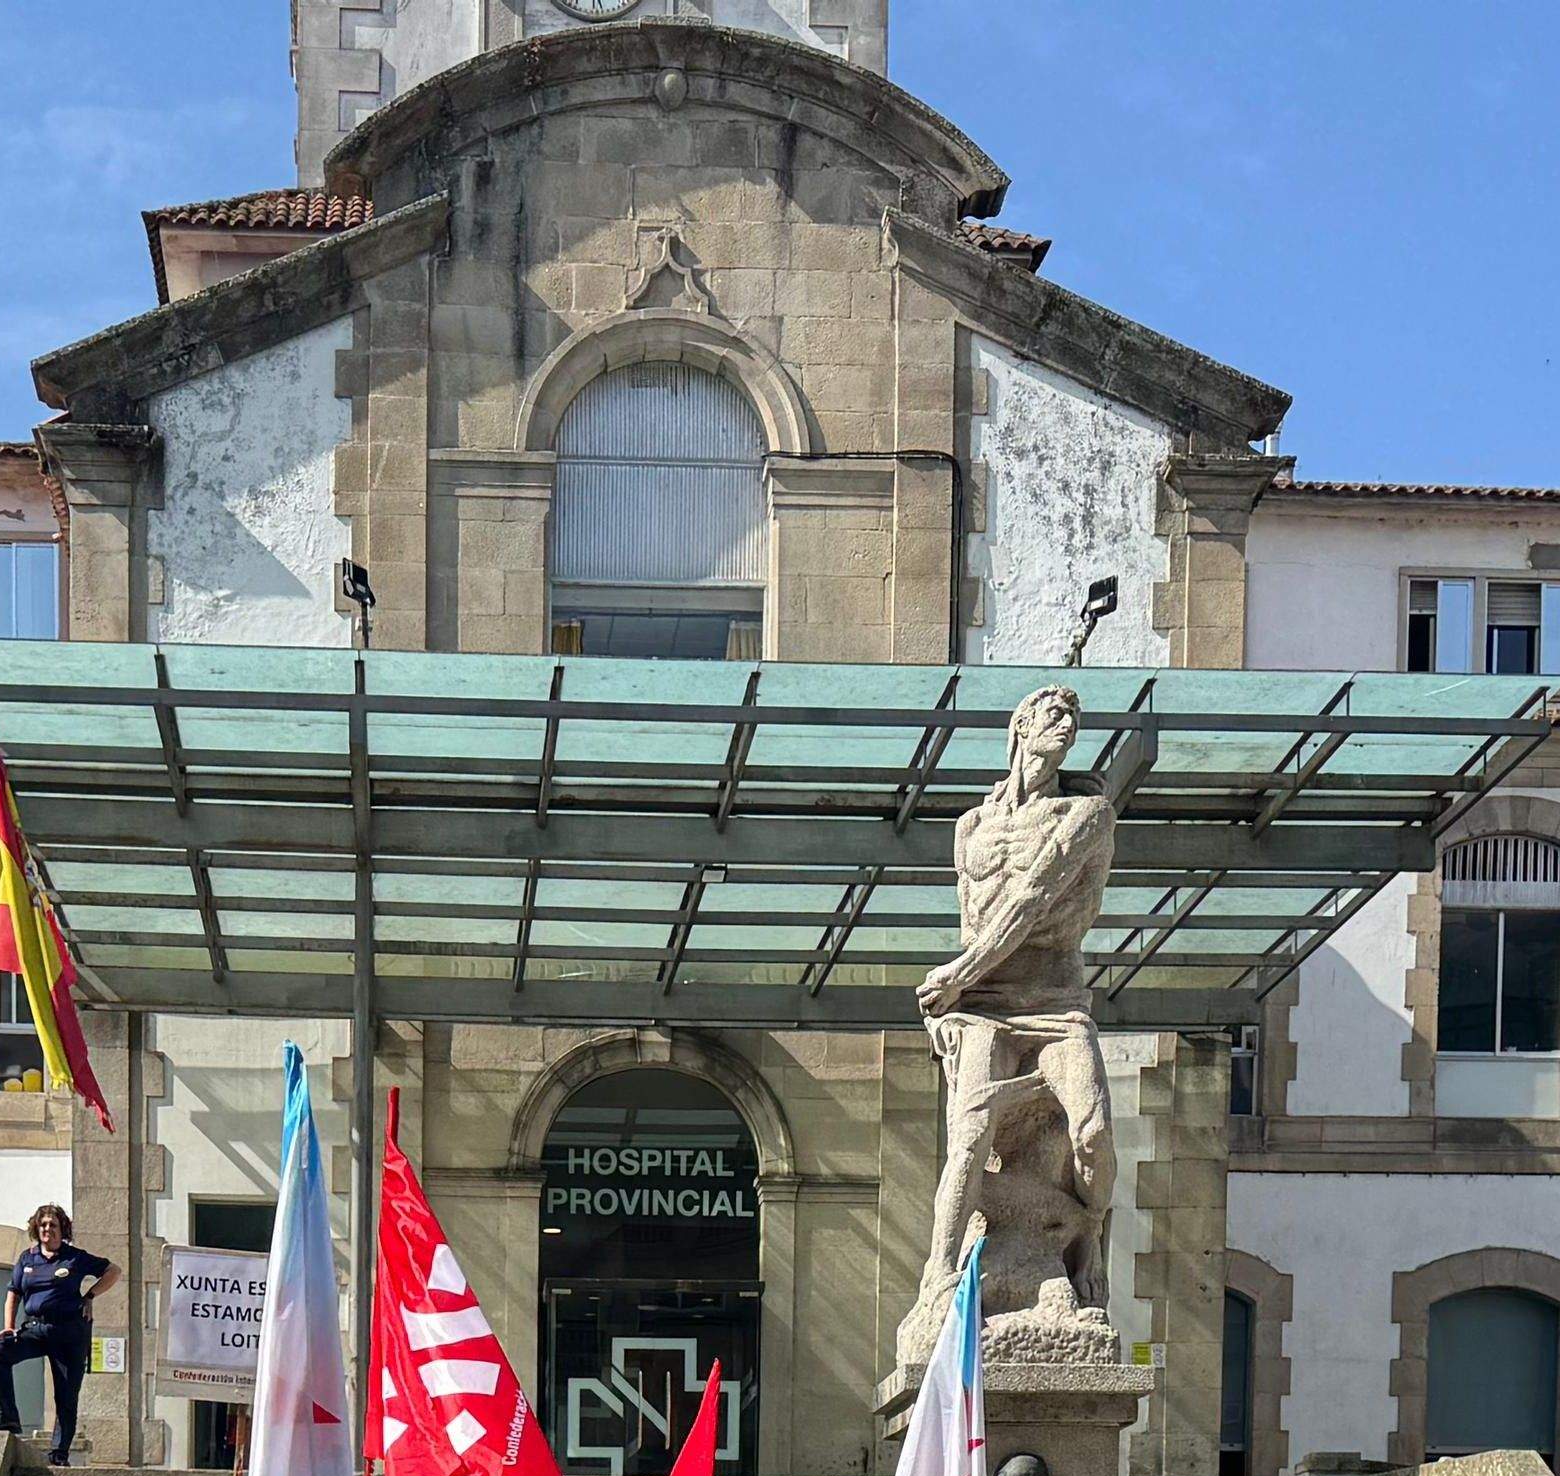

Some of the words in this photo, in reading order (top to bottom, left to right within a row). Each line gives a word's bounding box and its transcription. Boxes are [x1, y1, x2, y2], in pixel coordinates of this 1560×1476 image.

[568, 1149, 734, 1176] HOSPITAL
[547, 1188, 754, 1217] PROVINCIAL
[176, 1275, 241, 1293] XUNTA
